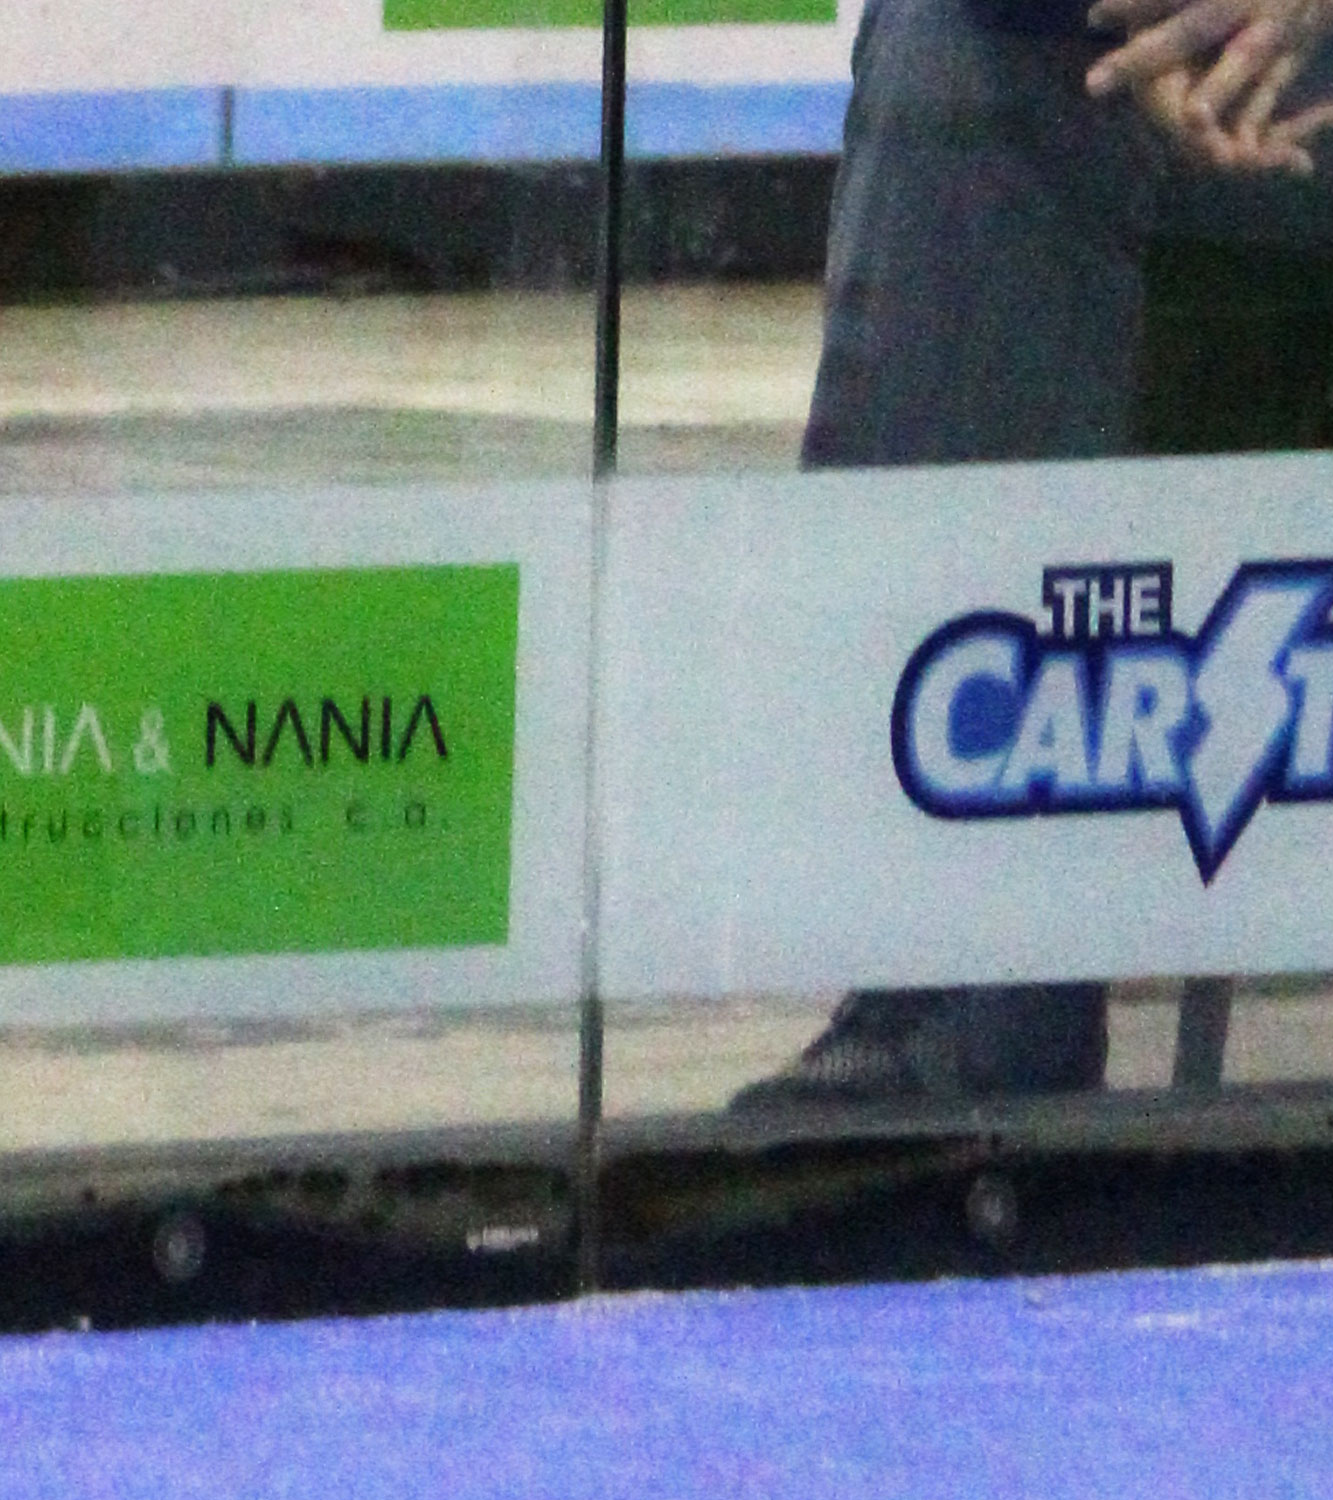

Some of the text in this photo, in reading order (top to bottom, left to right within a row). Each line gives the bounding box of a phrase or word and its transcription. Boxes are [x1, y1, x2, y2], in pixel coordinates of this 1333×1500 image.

[1050, 570, 1163, 638] THE
[132, 704, 173, 774] &
[206, 695, 449, 768] NANIA
